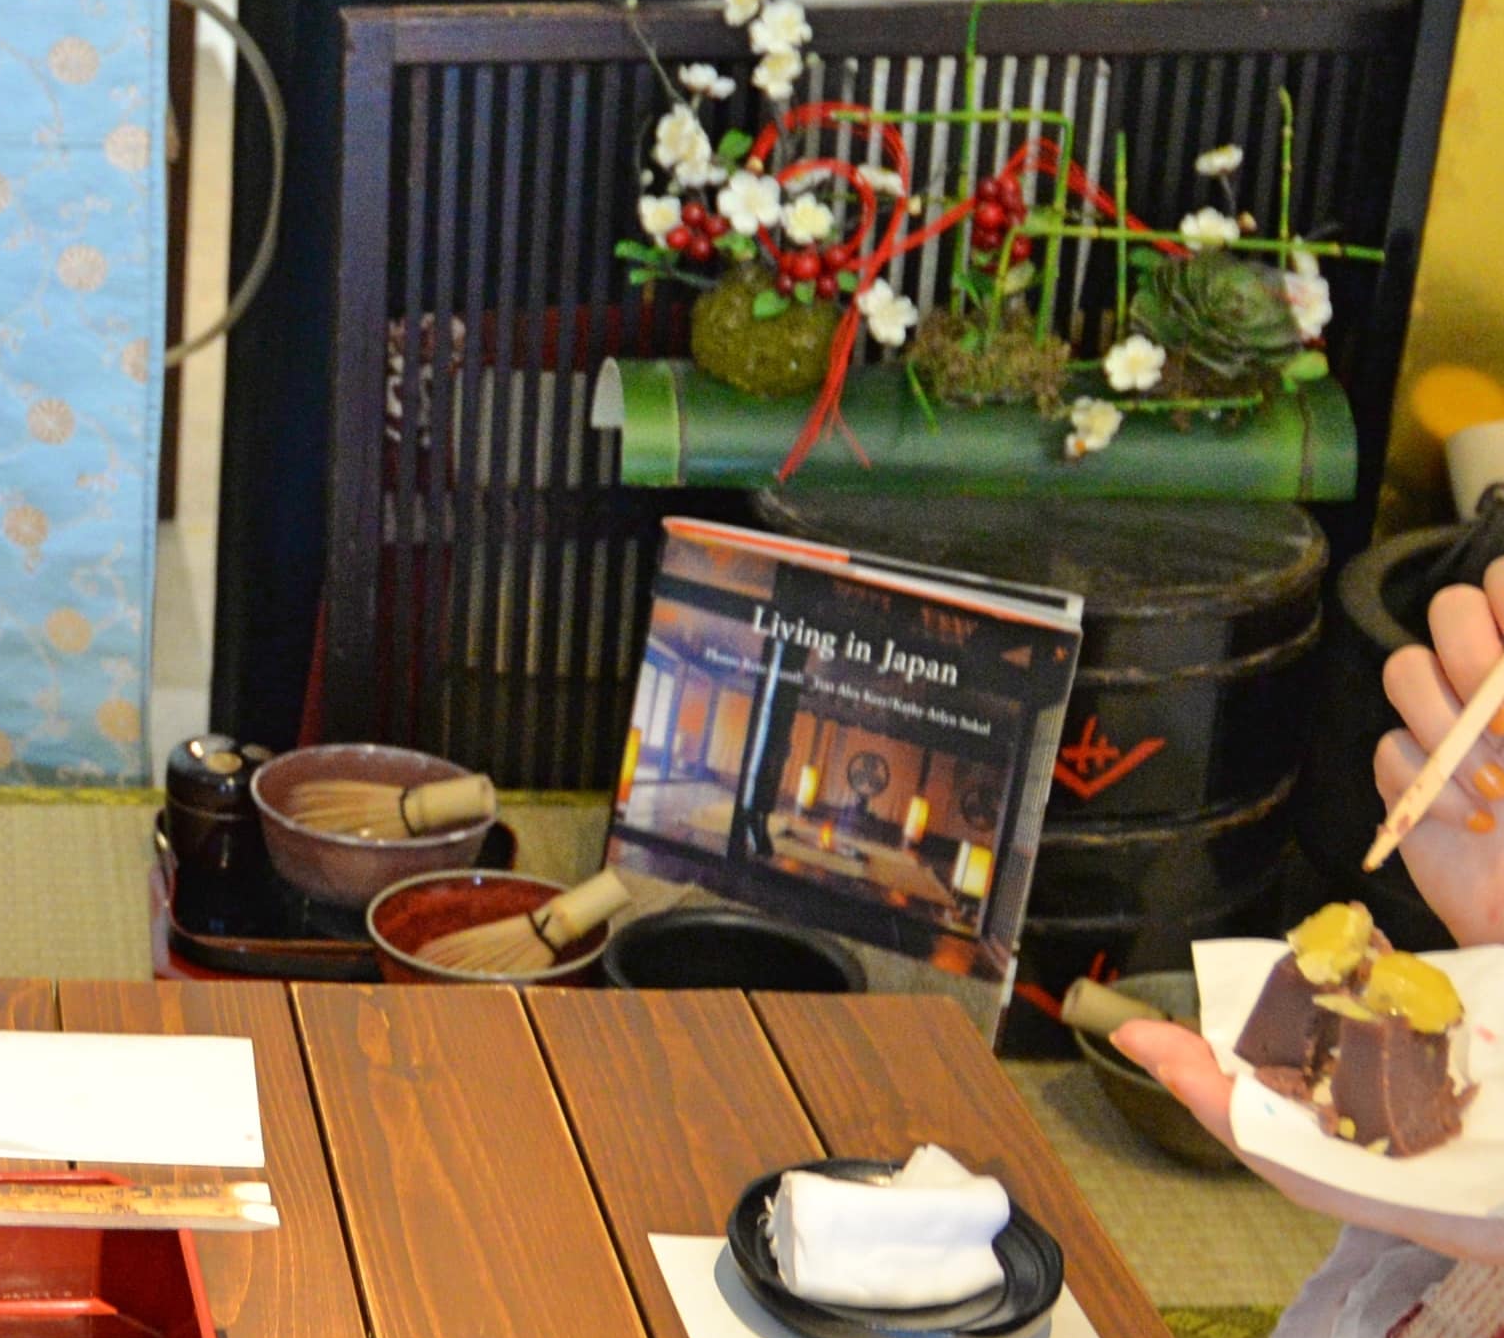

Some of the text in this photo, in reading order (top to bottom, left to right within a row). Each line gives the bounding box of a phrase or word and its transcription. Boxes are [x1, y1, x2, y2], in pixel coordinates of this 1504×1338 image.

[753, 605, 959, 686] Living in Japan
